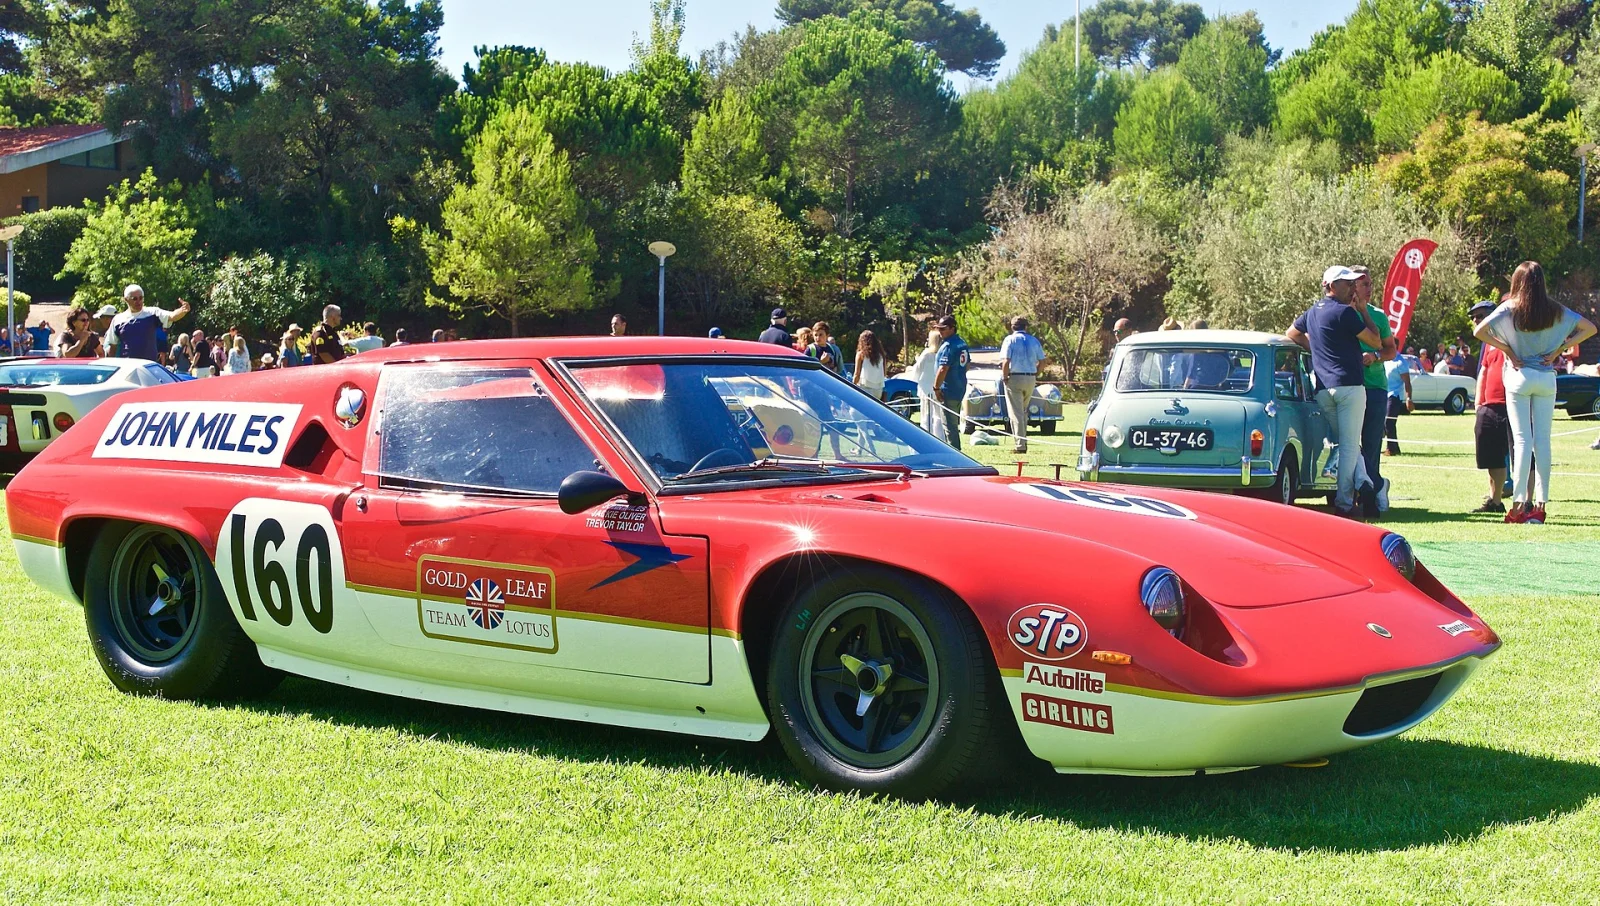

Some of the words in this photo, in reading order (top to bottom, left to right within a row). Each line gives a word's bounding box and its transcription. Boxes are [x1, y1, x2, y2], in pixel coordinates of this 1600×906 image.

[105, 411, 191, 448] JOHN
[185, 411, 285, 455] MILES
[1132, 430, 1208, 448] CL-37-46
[591, 509, 618, 520] JACKIE
[619, 510, 647, 521] OLIVER
[1030, 484, 1187, 518] 160
[585, 518, 615, 530] TREVOR
[616, 521, 645, 532] TAYLOR
[230, 513, 334, 634] 160
[425, 568, 468, 589] GOLD
[505, 578, 547, 599] LEAF
[426, 609, 467, 628] TEAM
[505, 619, 550, 638] LOTUS
[1014, 608, 1081, 655] STP
[1026, 665, 1104, 694] Autolite
[1026, 698, 1109, 729] GIRLING
